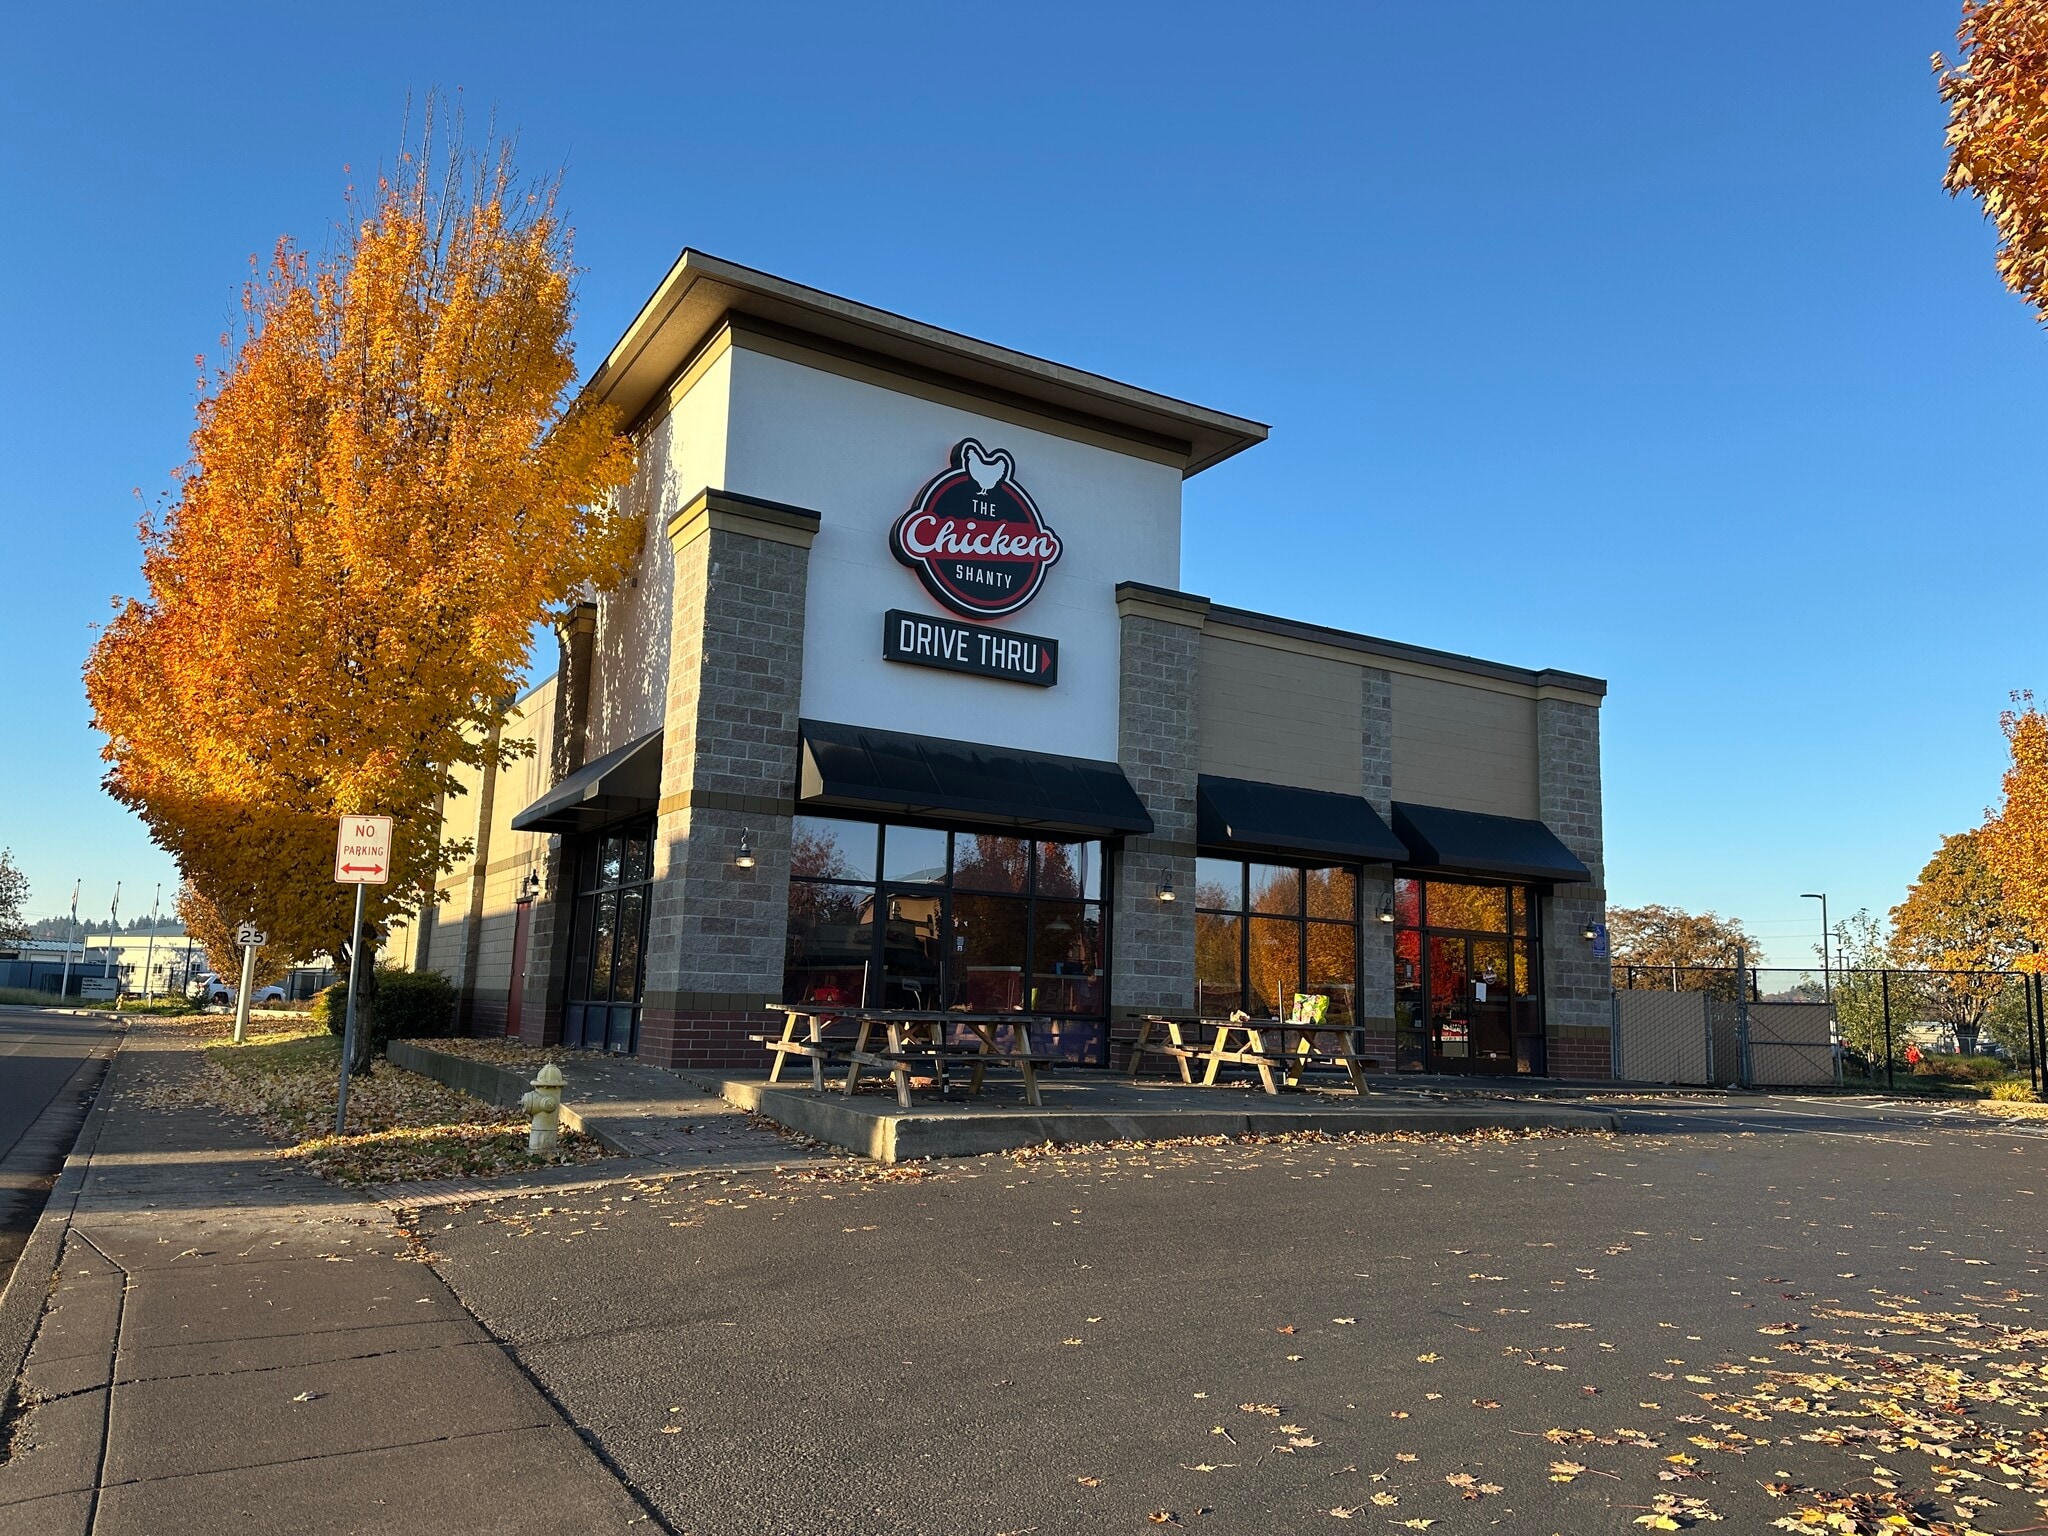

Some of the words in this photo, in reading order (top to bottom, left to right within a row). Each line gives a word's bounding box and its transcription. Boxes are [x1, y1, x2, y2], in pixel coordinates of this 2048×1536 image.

[972, 499, 996, 517] THE
[906, 515, 1054, 558] Chicken
[956, 564, 1013, 589] SHANTY
[899, 619, 970, 663] DRIVE
[978, 633, 1037, 674] THRU
[355, 824, 375, 837] NO
[343, 845, 384, 857] PARKING
[240, 930, 263, 943] 25
